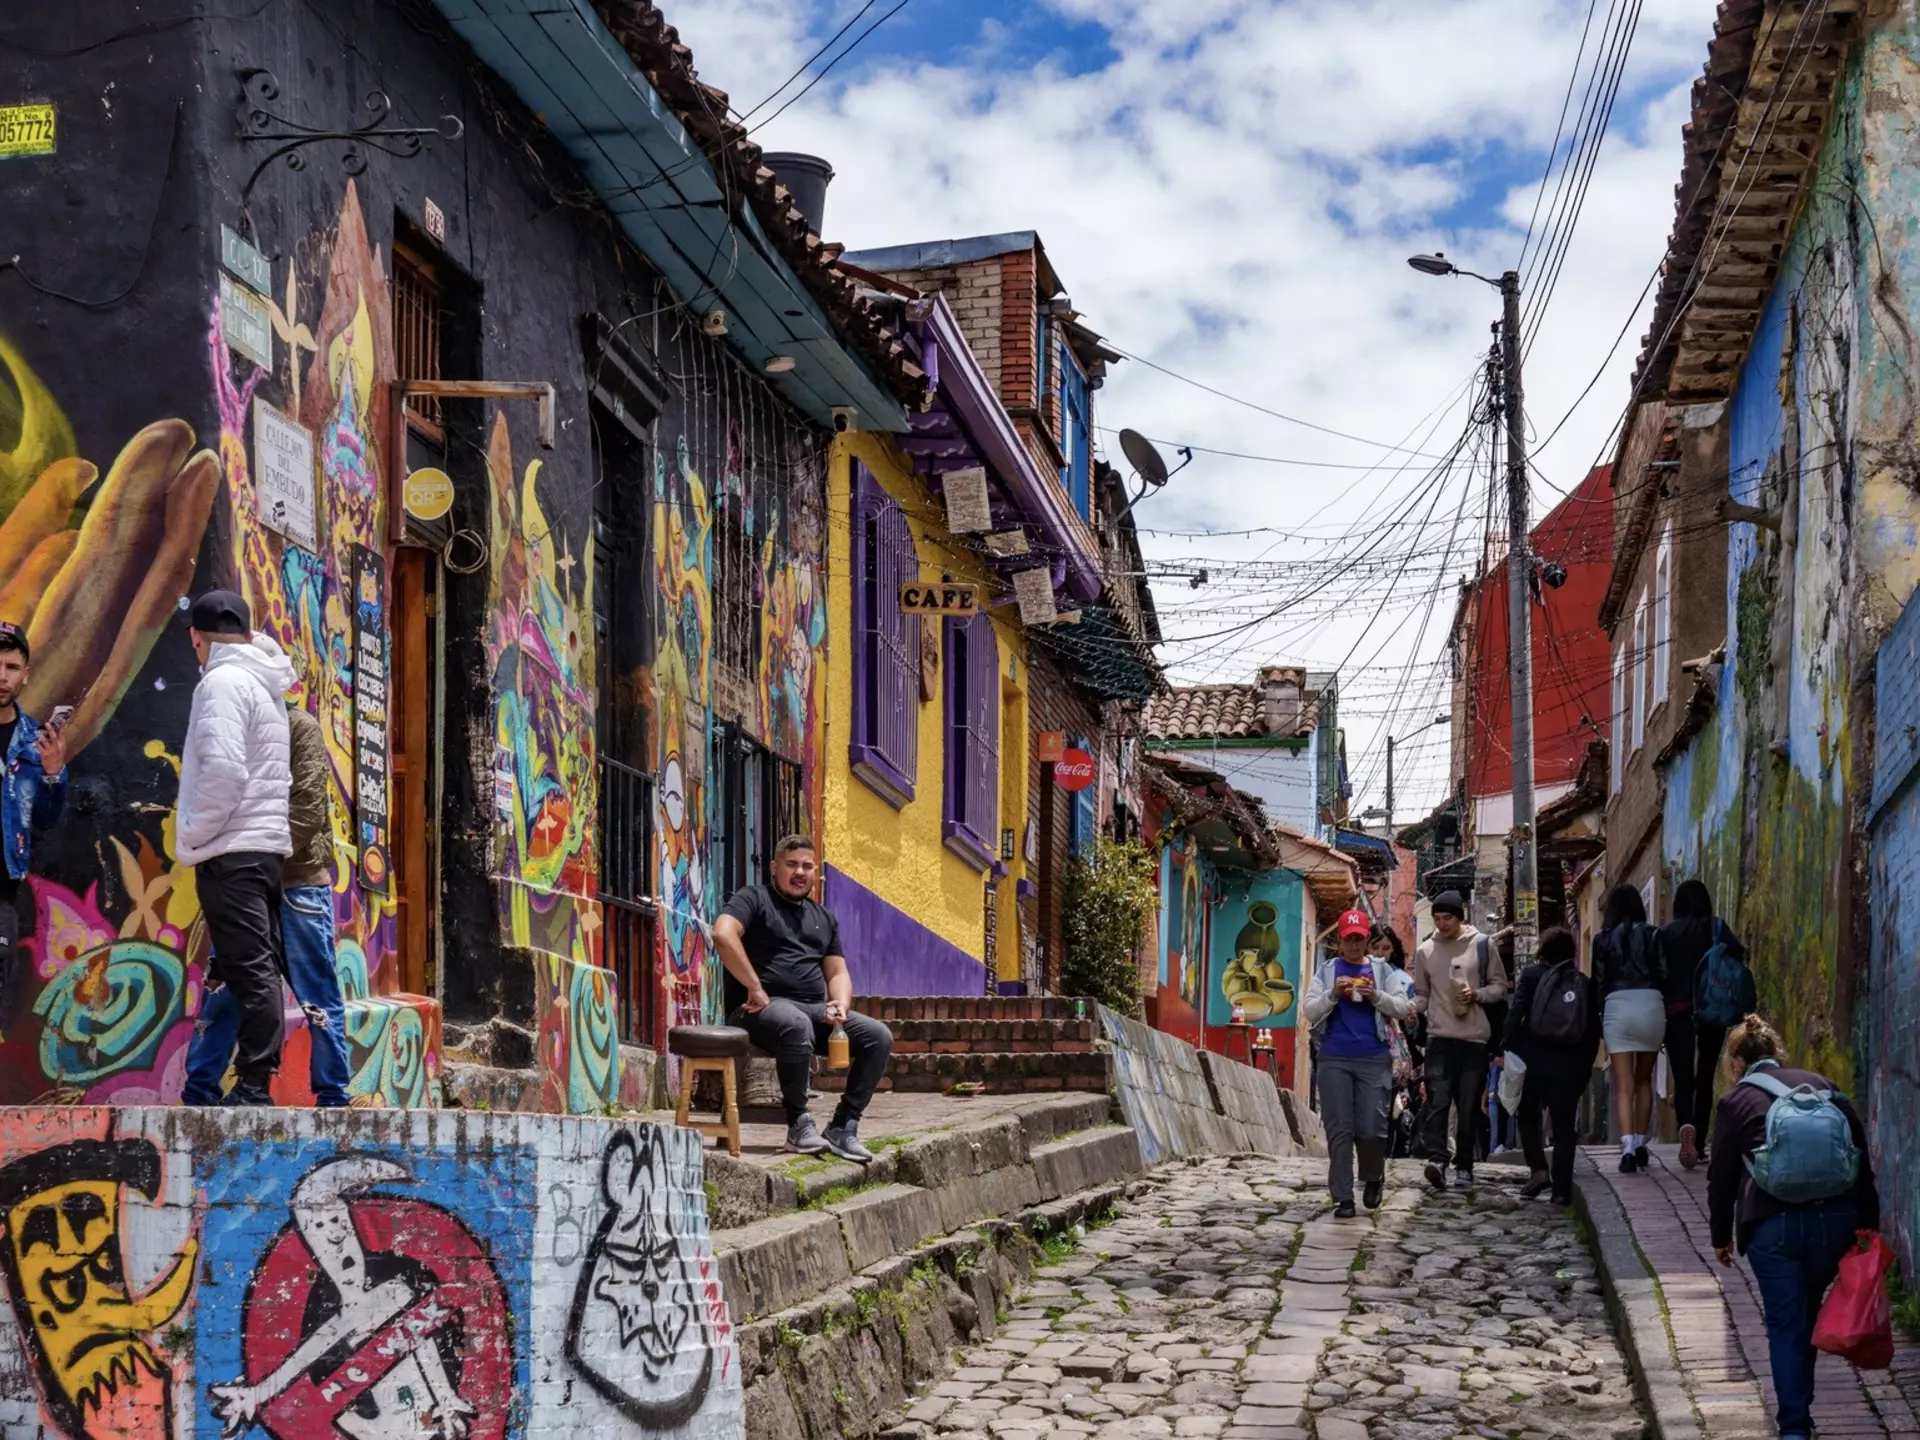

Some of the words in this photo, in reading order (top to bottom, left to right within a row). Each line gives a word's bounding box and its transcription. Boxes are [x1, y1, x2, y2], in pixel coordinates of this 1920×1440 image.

[252, 255, 263, 285] 12
[264, 464, 305, 504] EMBUDO
[903, 588, 973, 609] CAFE
